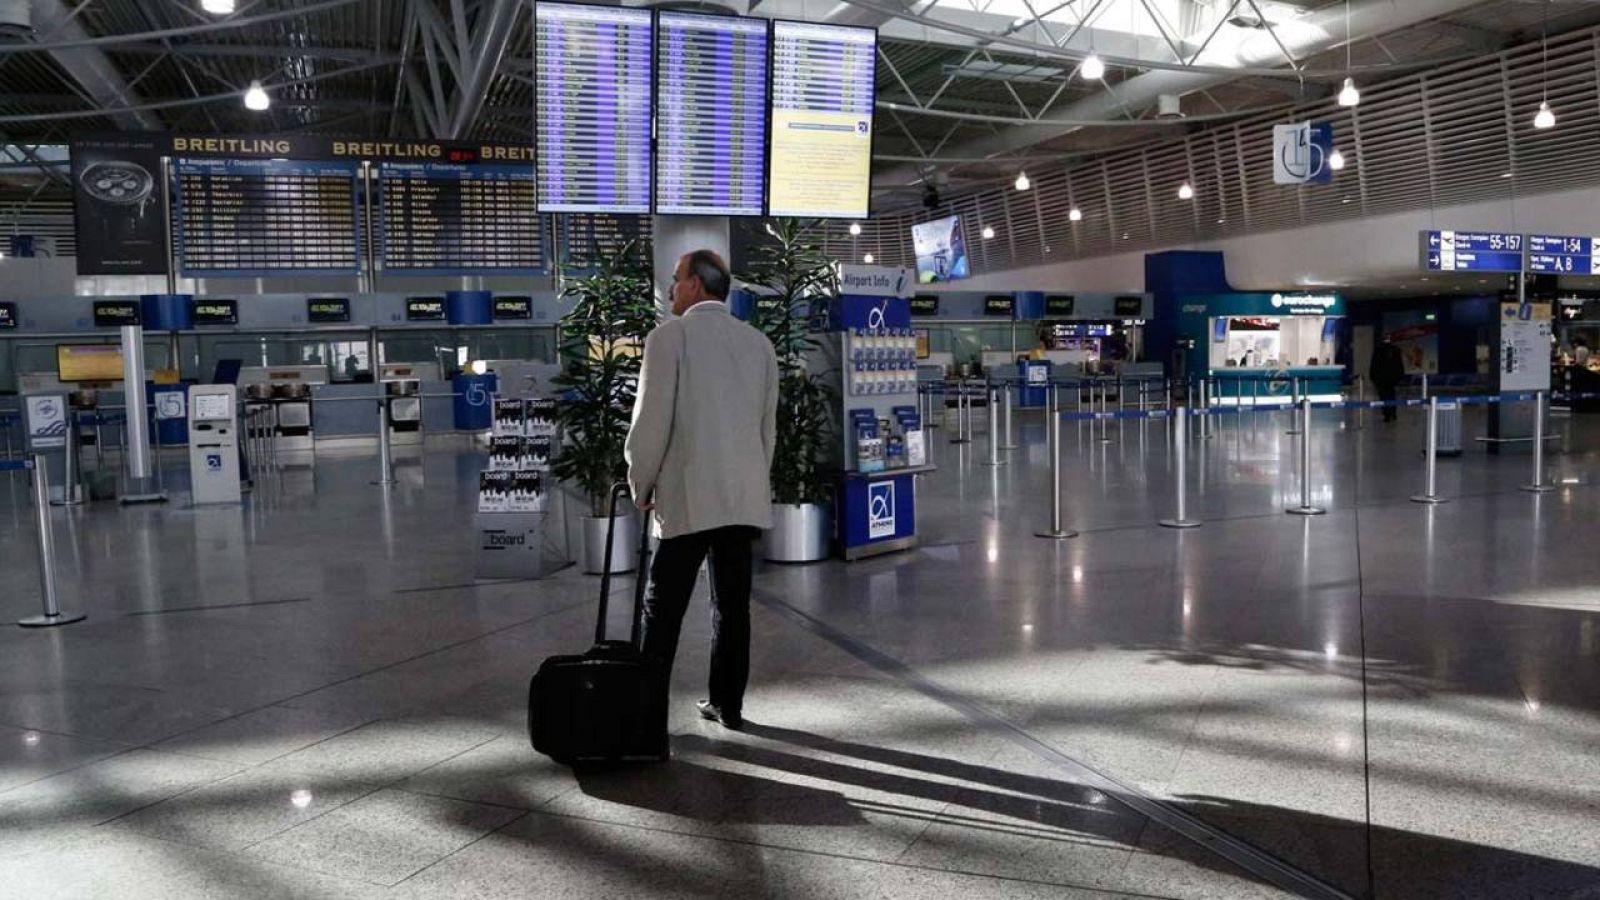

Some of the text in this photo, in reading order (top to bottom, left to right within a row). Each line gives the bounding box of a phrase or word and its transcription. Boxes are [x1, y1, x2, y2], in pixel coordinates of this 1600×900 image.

[173, 137, 290, 153] BREITLING
[333, 142, 441, 157] BREITLING
[1489, 234, 1521, 250] 55-157
[1563, 238, 1581, 253] 1-54
[844, 273, 889, 288] Airport Info
[484, 471, 507, 480] board
[514, 471, 538, 480] board
[490, 532, 526, 546] board
